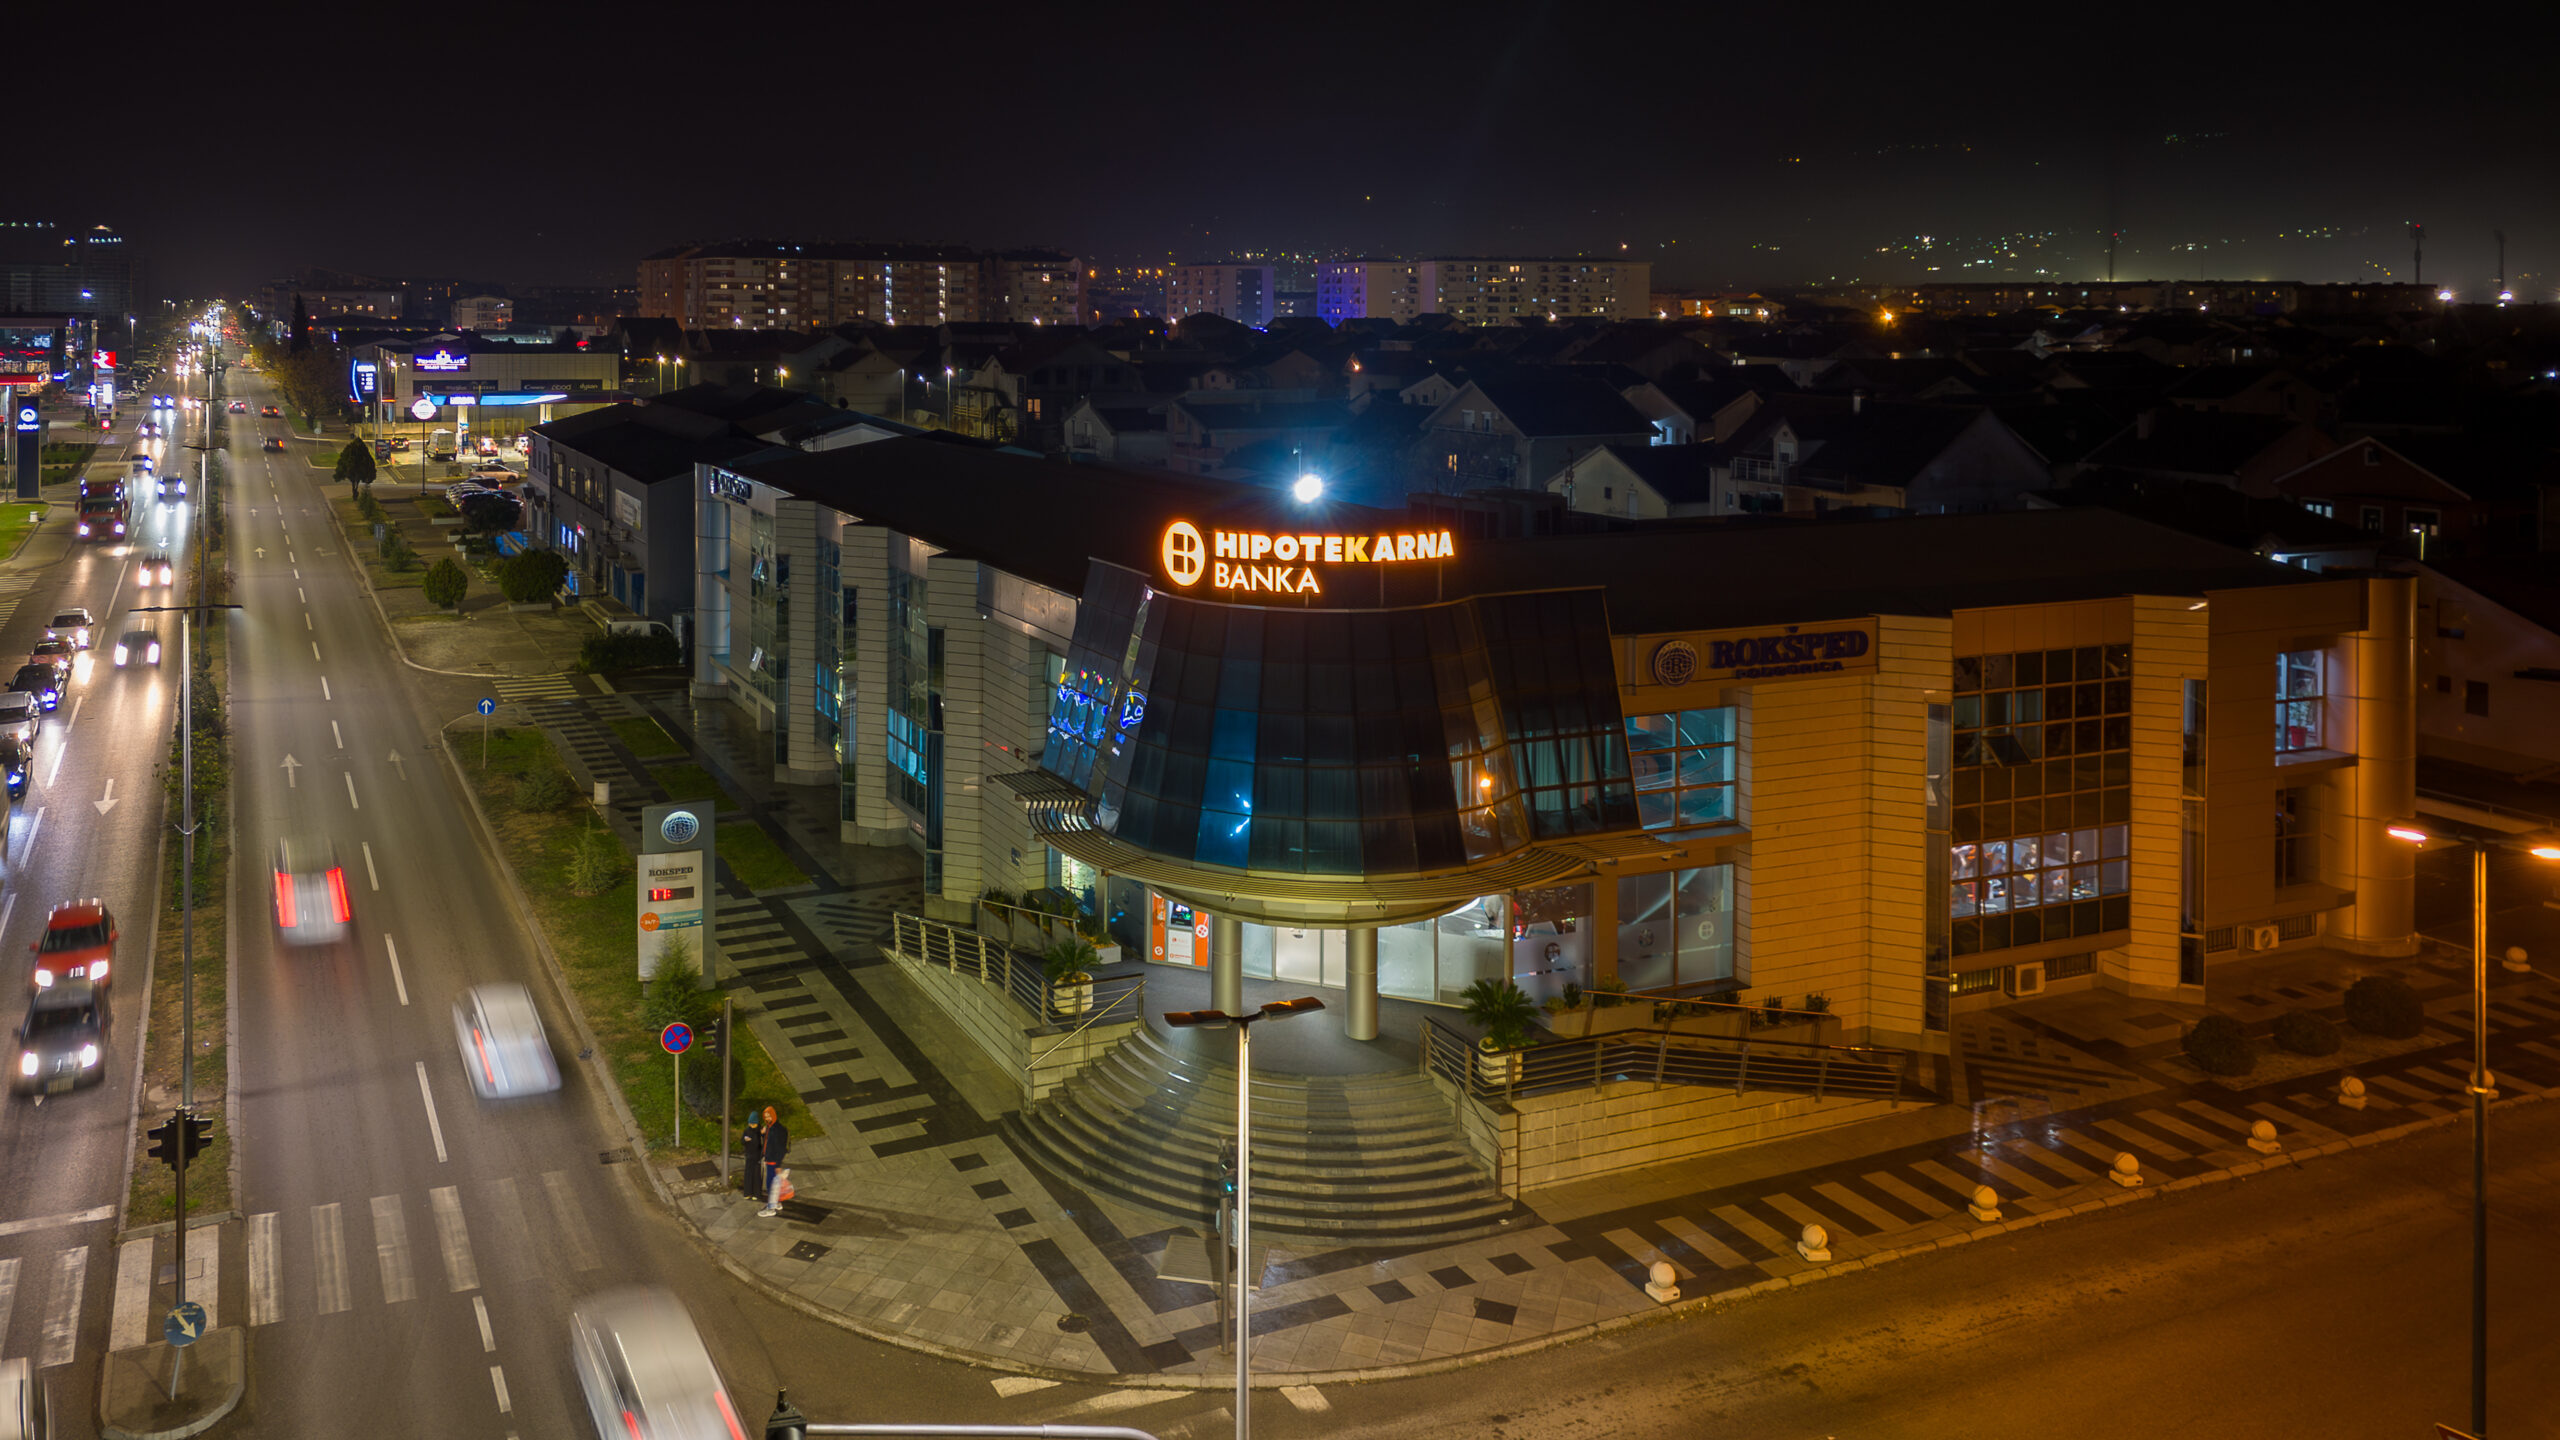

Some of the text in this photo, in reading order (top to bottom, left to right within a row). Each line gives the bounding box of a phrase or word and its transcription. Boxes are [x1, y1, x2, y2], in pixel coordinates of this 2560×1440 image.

[1214, 531, 1454, 562] HIPOTEKARNA
[1214, 562, 1320, 593] BANKA
[1708, 626, 1869, 669] ROKŠPED
